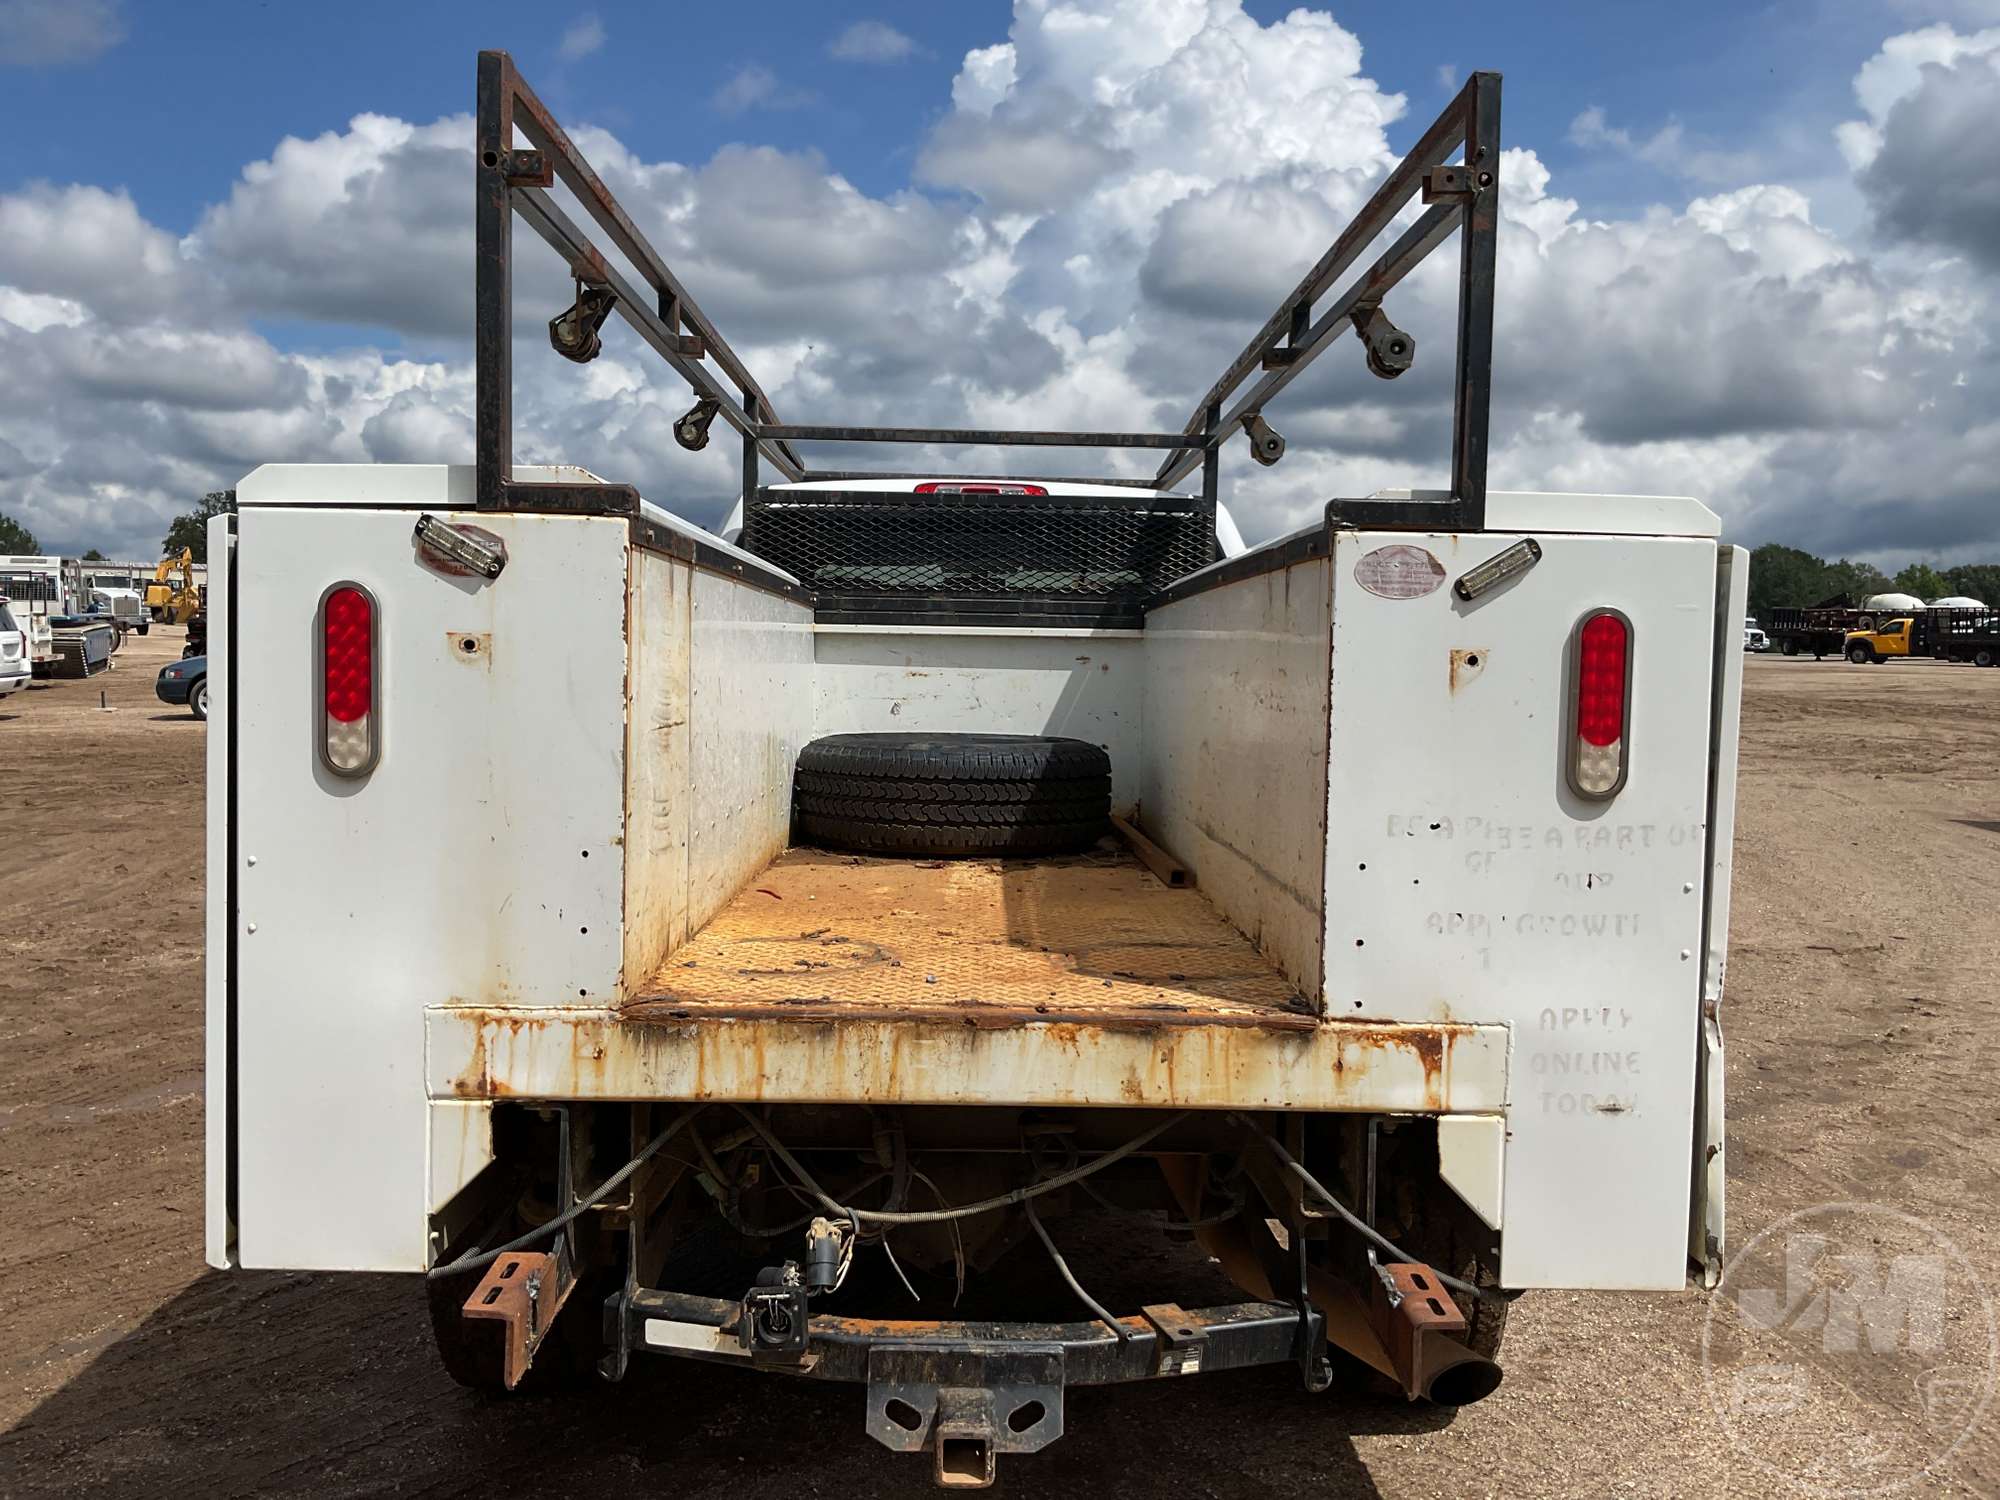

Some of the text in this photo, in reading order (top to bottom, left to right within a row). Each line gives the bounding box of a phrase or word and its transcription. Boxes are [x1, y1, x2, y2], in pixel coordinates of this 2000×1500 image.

[1543, 825, 1564, 849] A
[1573, 823, 1656, 849] PART
[1530, 1050, 1641, 1075] ONLINE
